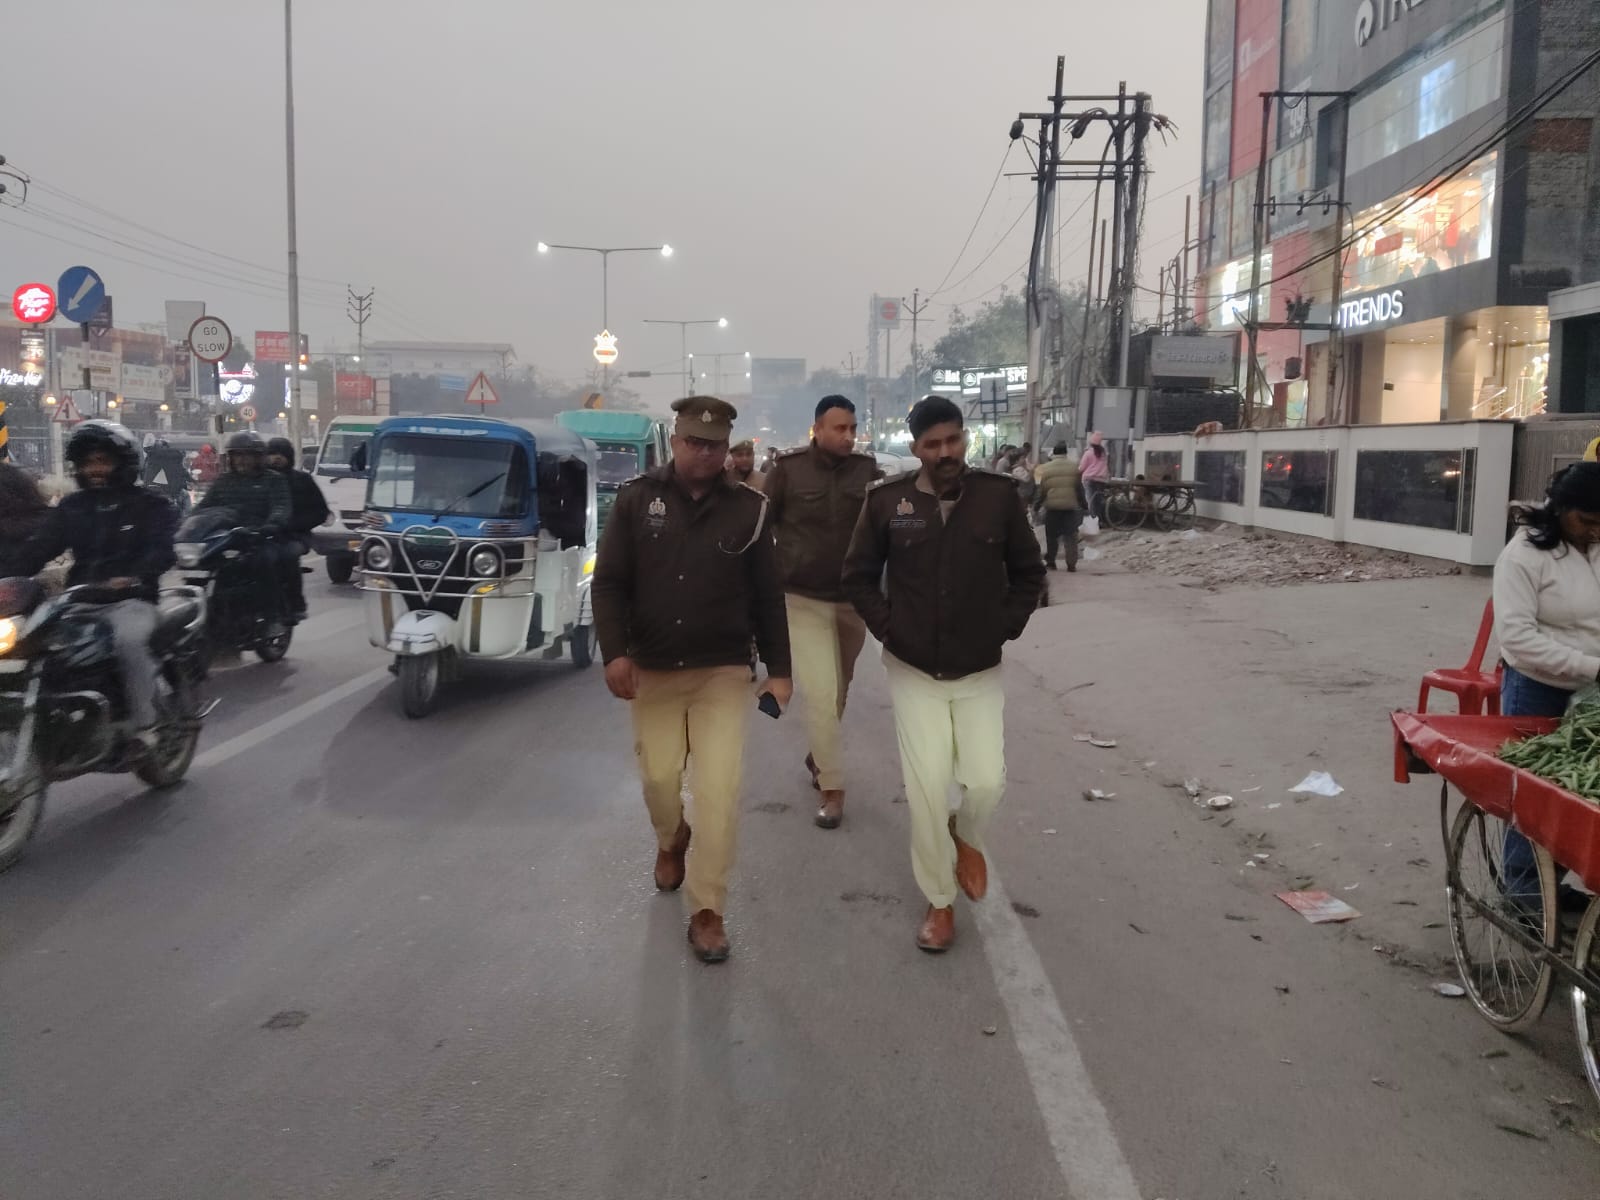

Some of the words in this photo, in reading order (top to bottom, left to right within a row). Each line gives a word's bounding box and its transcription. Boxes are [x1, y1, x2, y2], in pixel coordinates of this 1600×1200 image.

[1341, 289, 1404, 329] TRENDS
[203, 326, 218, 336] GO
[197, 343, 225, 353] SLOW
[0, 367, 24, 386] Pizza
[243, 407, 253, 417] 40
